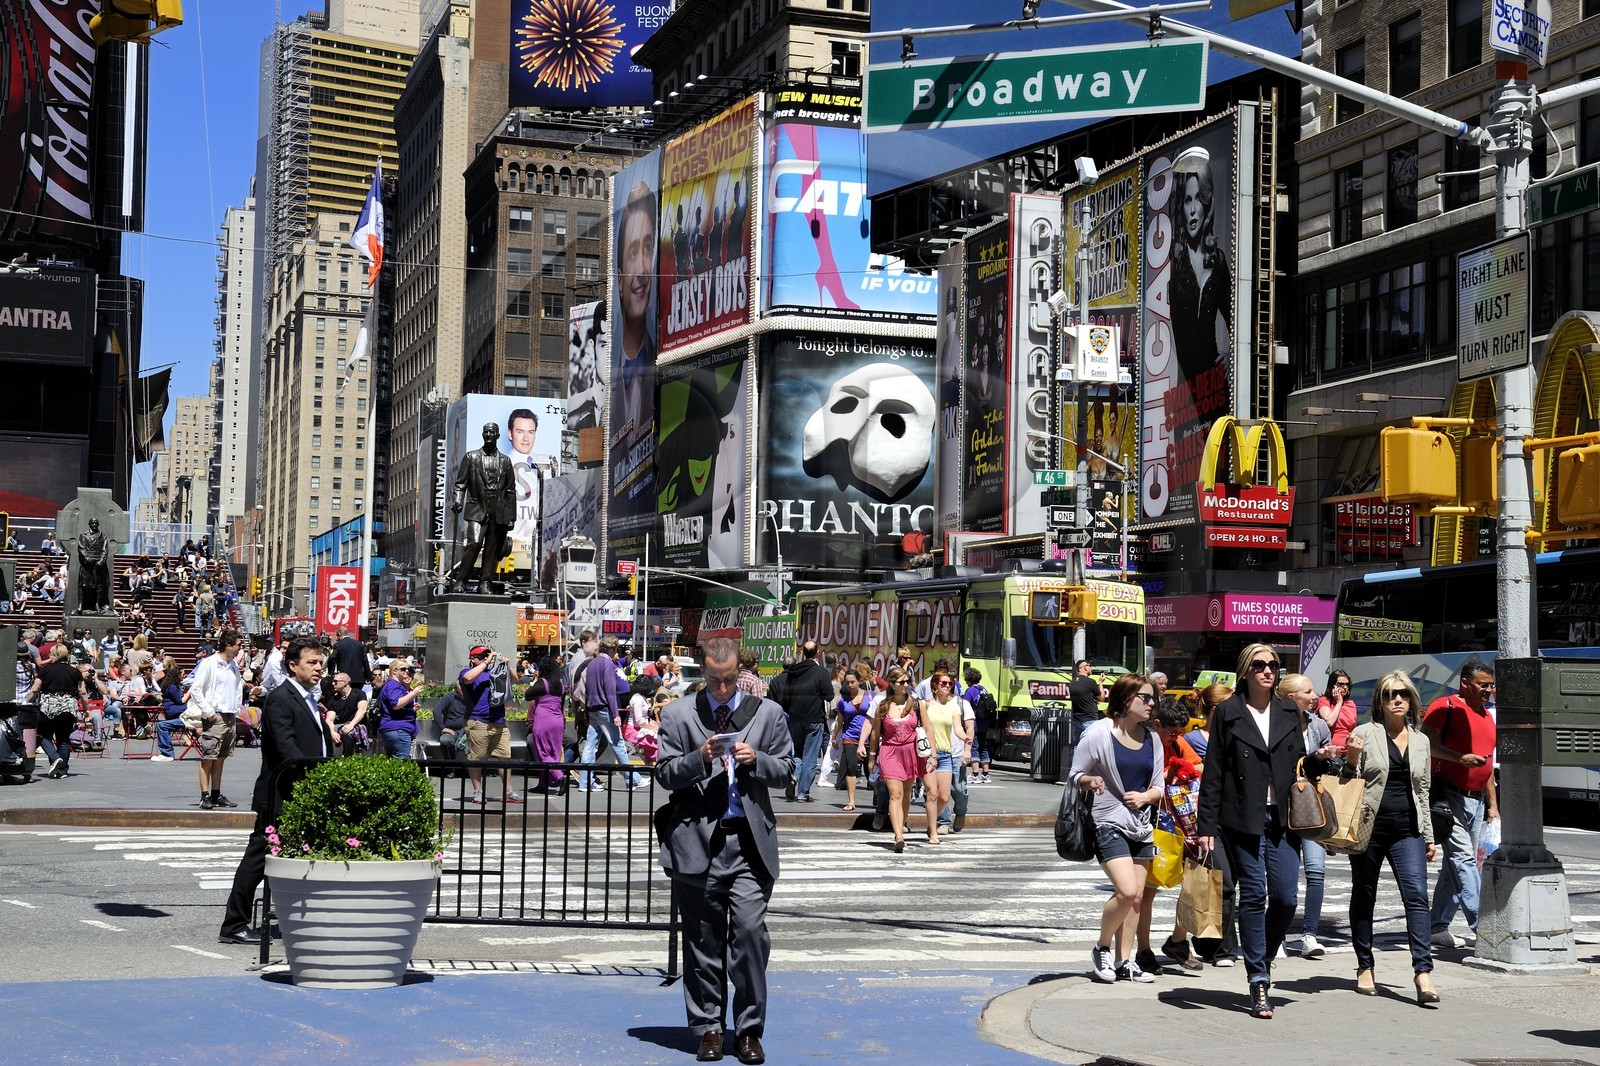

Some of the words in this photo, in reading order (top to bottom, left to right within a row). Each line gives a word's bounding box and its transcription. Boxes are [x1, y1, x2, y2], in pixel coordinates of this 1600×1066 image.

[638, 17, 669, 28] FEST
[1495, 0, 1549, 37] SECURITY
[1496, 20, 1543, 57] CAMERA
[913, 68, 1147, 110] Broadway
[810, 93, 863, 108] MUSIC
[701, 103, 753, 149] CROWD
[798, 109, 850, 122] brought
[852, 115, 862, 124] y
[669, 151, 708, 188] GOES
[768, 159, 867, 217] CAT
[1549, 184, 1563, 214] 7
[1574, 175, 1589, 194] AV
[1099, 209, 1125, 244] EVER
[1074, 241, 1112, 282] WNTED
[1114, 234, 1130, 264] ON
[38, 274, 81, 283] HYUNDAI
[1461, 261, 1492, 290] RIGHT
[1496, 251, 1526, 279] LANE
[667, 270, 713, 336] JERSEY
[714, 255, 748, 321] BOYS
[861, 277, 882, 290] IF
[888, 279, 931, 294] YOU
[0, 306, 73, 331] ANTRA
[1474, 293, 1512, 326] MUST
[1026, 217, 1053, 464] PALACE
[1143, 155, 1175, 517] CHICAGO
[795, 335, 850, 357] Tonight
[853, 338, 907, 360] belongs
[1461, 339, 1488, 365] TURN
[1492, 330, 1526, 357] RIGHT
[1164, 363, 1226, 418] DROP-DEAD
[546, 405, 567, 415] fra
[1165, 389, 1227, 433] GORGEOUS
[561, 416, 567, 425] &
[984, 409, 1004, 432] The
[1036, 472, 1043, 484] W
[1044, 472, 1055, 484] 46
[1204, 494, 1290, 511] McDonald's
[761, 499, 934, 537] PHANTO
[1057, 512, 1073, 521] ONE
[1217, 510, 1275, 520] Restaurant
[663, 513, 703, 548] WICKED
[1062, 533, 1073, 543] ONE
[1076, 533, 1088, 543] WAY
[1210, 533, 1236, 542] OPEN
[1238, 533, 1250, 542] 24
[1009, 548, 1016, 556] OF
[1152, 535, 1172, 551] FUEL
[1129, 554, 1144, 562] THE
[328, 571, 357, 626] tkts
[1111, 584, 1139, 602] DAY
[703, 602, 732, 630] sbarro
[734, 599, 765, 628] sbarro
[1098, 603, 1138, 621] 2011
[1154, 604, 1174, 616] SQUARE
[1231, 602, 1263, 613] TIMES
[1264, 602, 1303, 614] SQUARE
[516, 622, 558, 638] GIFTS
[602, 621, 633, 634] GIFTS
[747, 620, 796, 640] JUDGMEN
[796, 601, 907, 647] JUDGMENT
[916, 598, 961, 648] DAY
[1157, 616, 1177, 627] CENTER
[1231, 614, 1269, 626] VISITOR
[1272, 615, 1309, 627] CENTER
[466, 630, 498, 639] GEORGE
[767, 645, 779, 663] 21,
